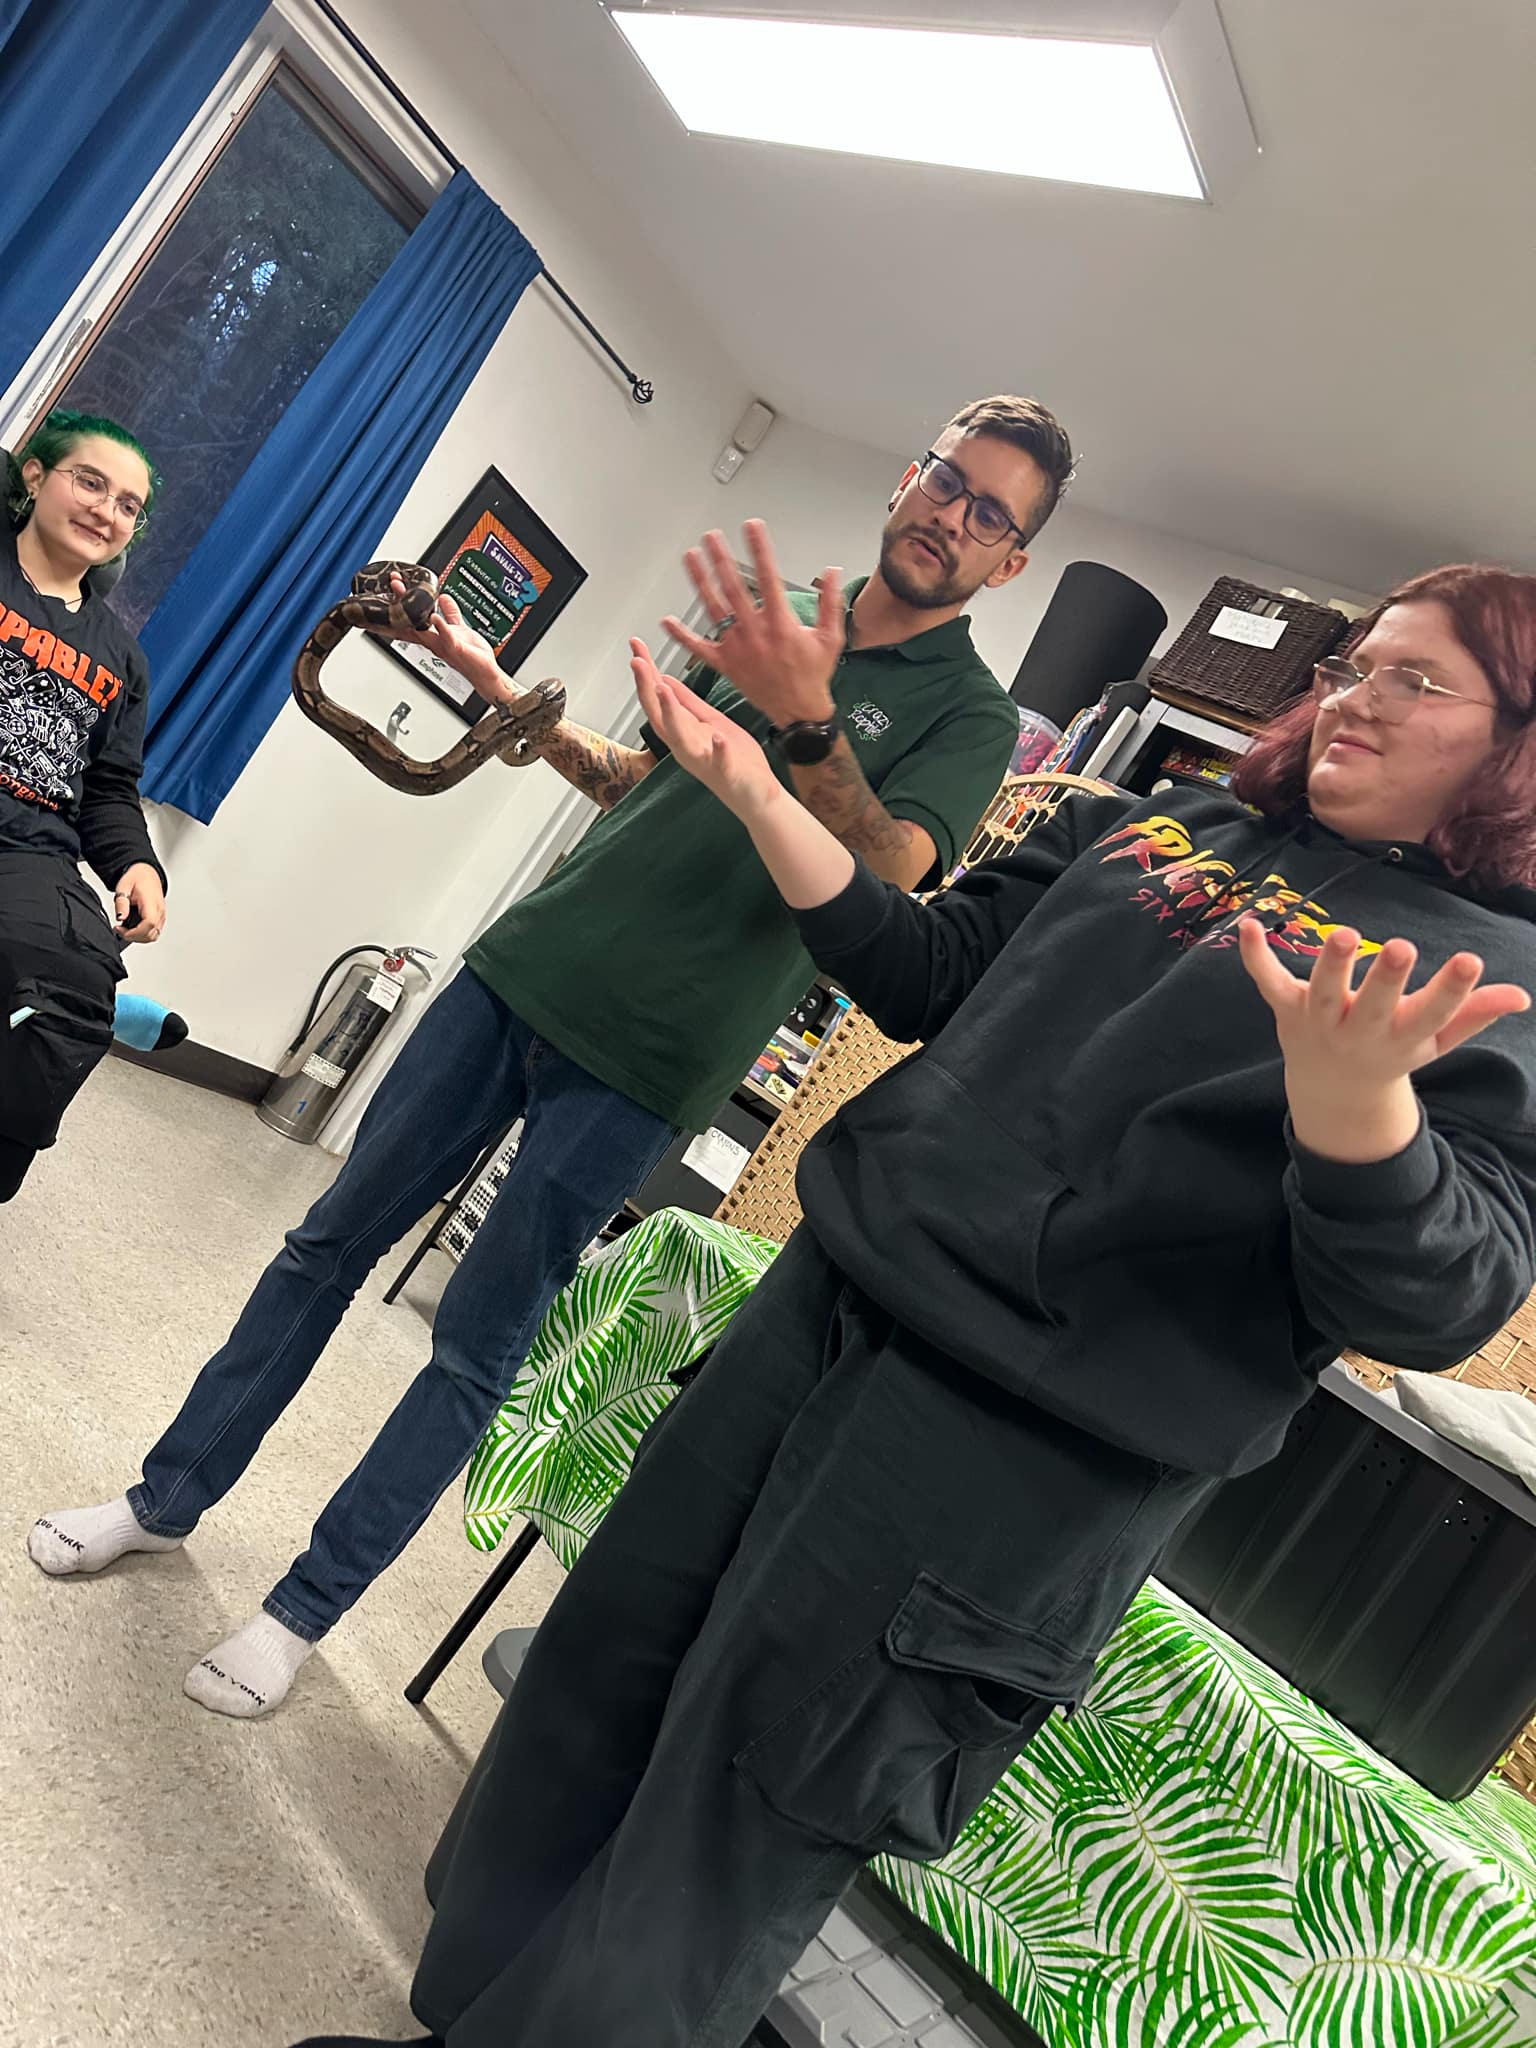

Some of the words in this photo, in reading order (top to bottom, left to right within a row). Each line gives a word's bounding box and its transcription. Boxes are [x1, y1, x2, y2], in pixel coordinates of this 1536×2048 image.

[0, 602, 123, 712] PABLE!
[1127, 888, 1175, 924] SIX
[200, 1659, 226, 1678] ZOO
[229, 1675, 266, 1706] YORK
